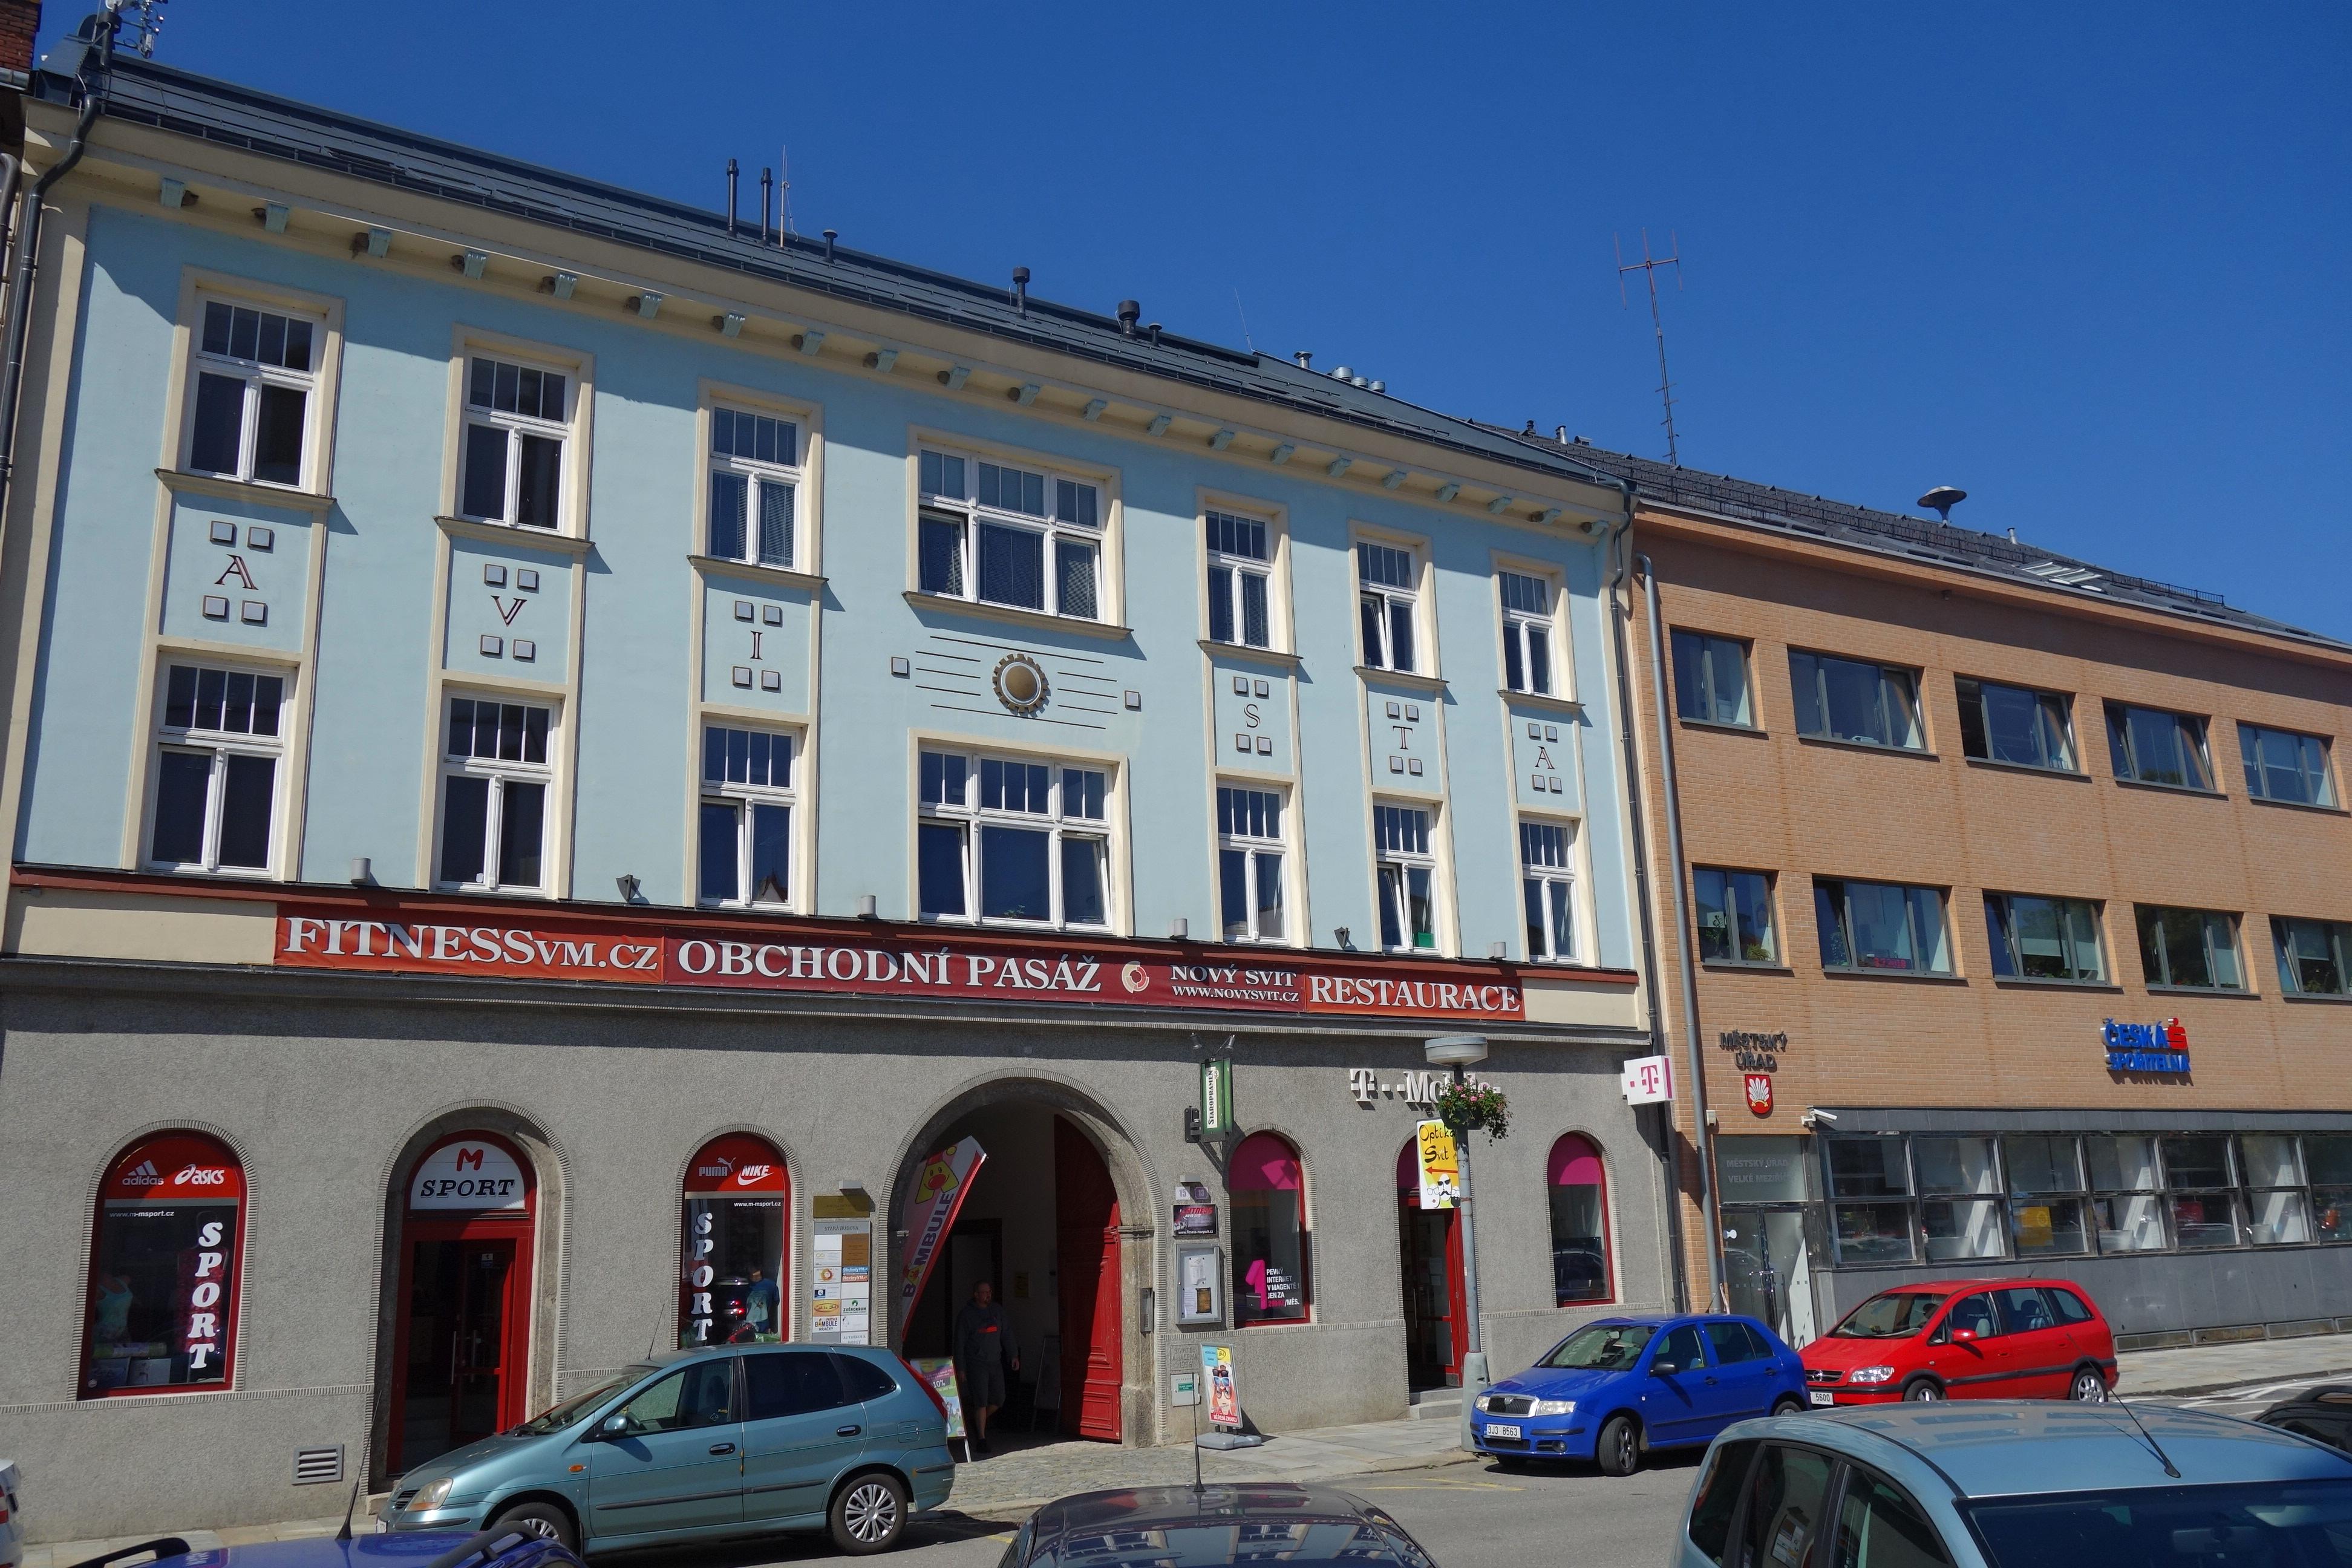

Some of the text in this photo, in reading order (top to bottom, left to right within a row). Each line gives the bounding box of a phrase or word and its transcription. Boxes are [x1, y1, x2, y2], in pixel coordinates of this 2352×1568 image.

[214, 553, 259, 590] A
[490, 595, 528, 627] V
[1243, 704, 1261, 728] S
[1392, 725, 1414, 750] T
[1534, 745, 1556, 770] A
[678, 940, 1102, 992] OBCHODNÍ PASÁŽ
[1170, 963, 1297, 987] NOVÝ SVIT
[1307, 974, 1521, 1012] RESTAURACE
[1719, 1028, 1788, 1049] MĚSTSKÝ
[2102, 1018, 2169, 1048] ČESKÁ
[1735, 1050, 1777, 1068] ÚŘAD
[2108, 1049, 2192, 1073] SPOŘITELNA
[1419, 1124, 1456, 1144] Optika
[456, 1148, 484, 1172] M
[1424, 1145, 1449, 1163] Svit
[699, 1166, 728, 1177] PUMA
[740, 1165, 771, 1177] NIKE
[122, 1176, 165, 1186] adidas
[420, 1179, 515, 1198] SPORT
[1178, 1189, 1187, 1197] 15
[691, 1212, 714, 1341] SPORT
[1266, 1267, 1284, 1276] PEVNÝ
[1267, 1275, 1293, 1284] INTERNET
[187, 1221, 224, 1369] SPORT
[932, 1379, 946, 1388] 10%
[1488, 1425, 1518, 1437] 3J3 8563
